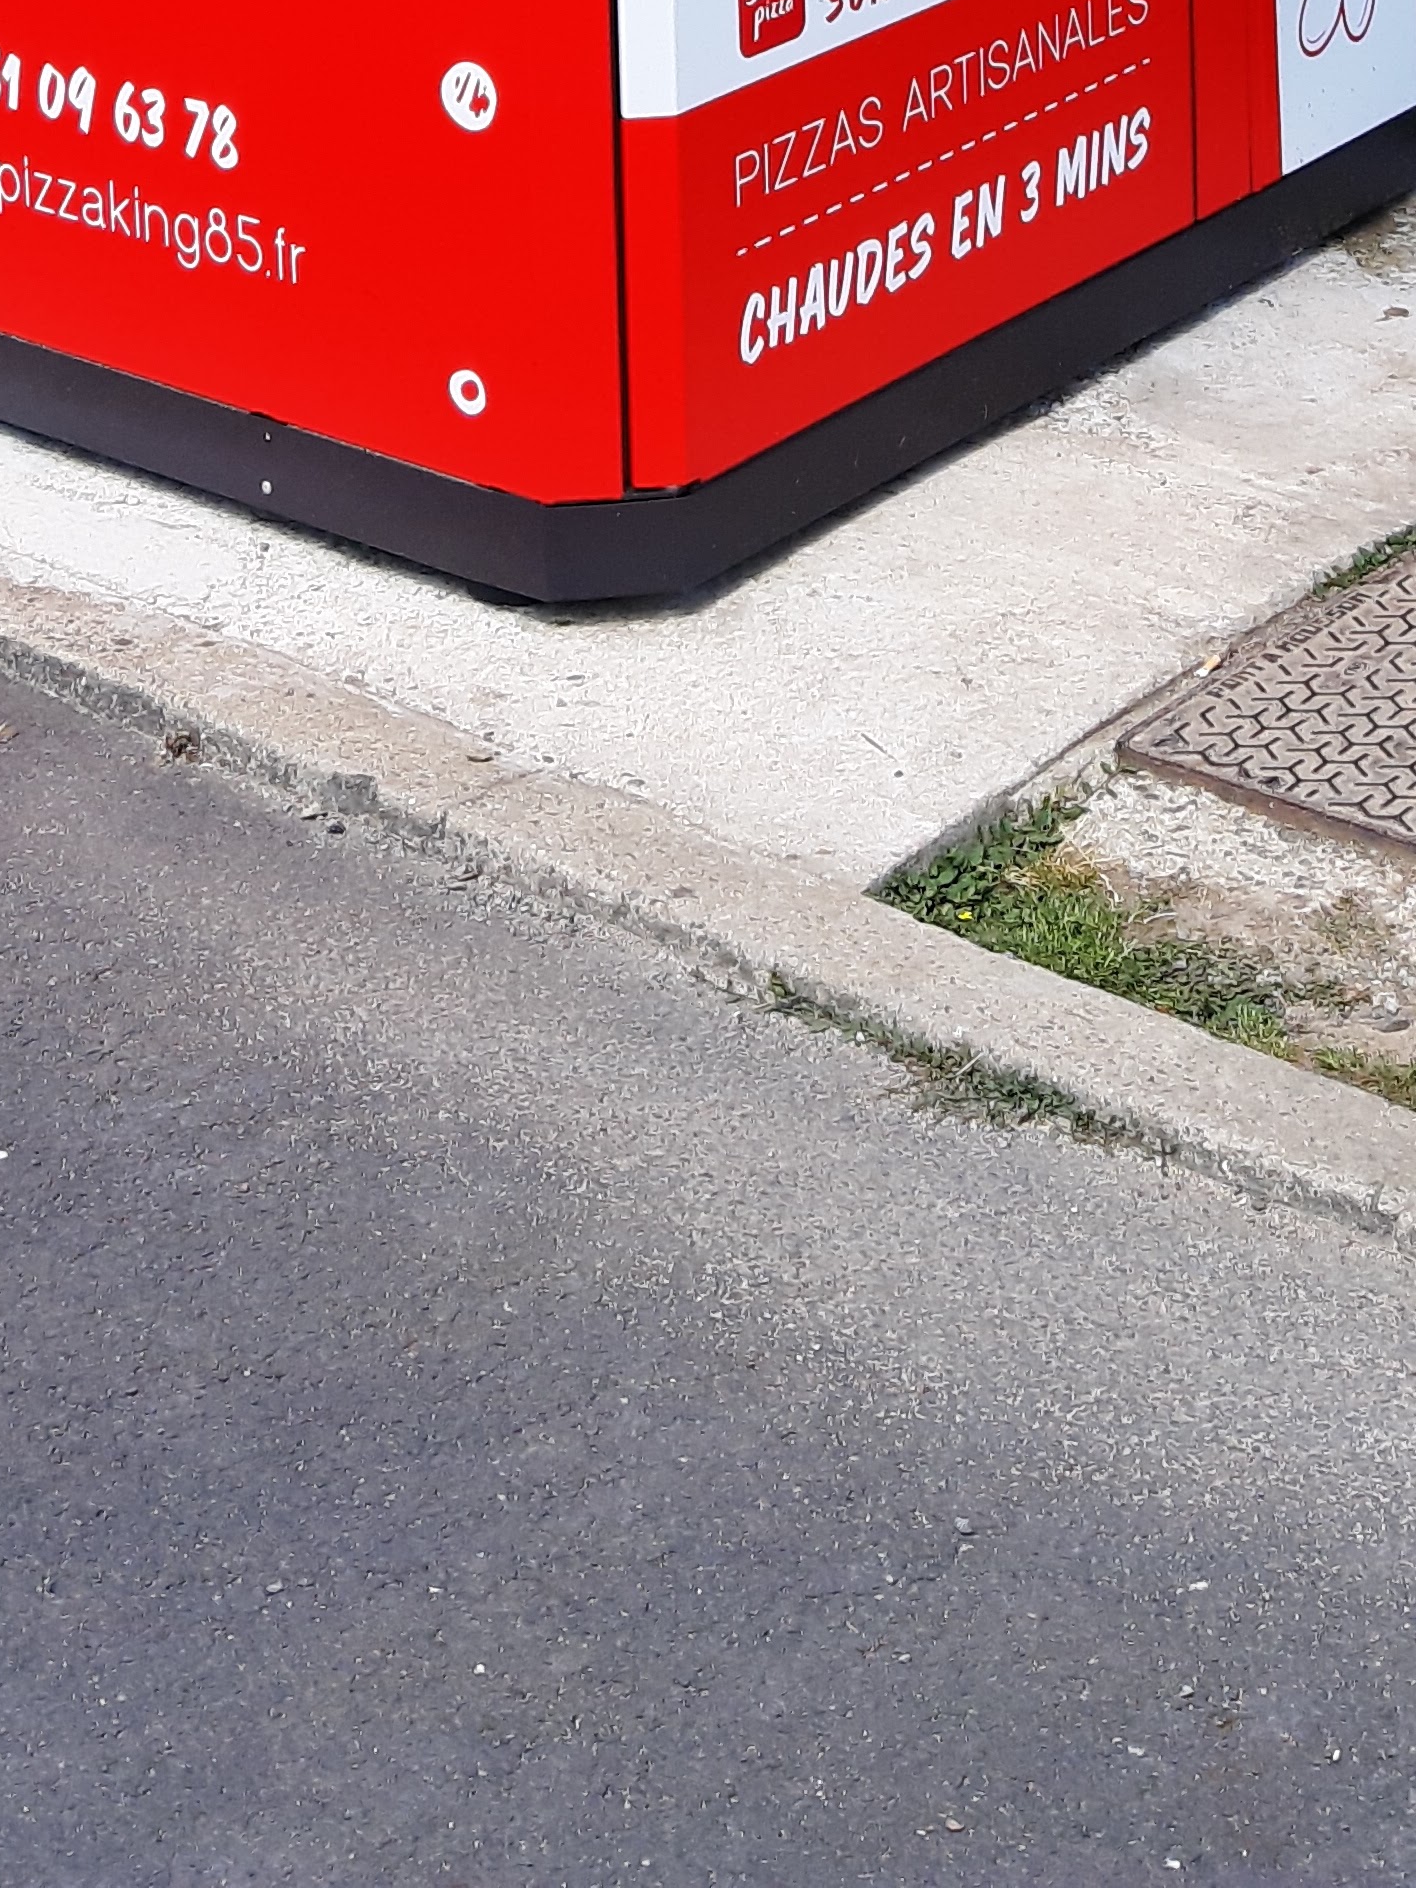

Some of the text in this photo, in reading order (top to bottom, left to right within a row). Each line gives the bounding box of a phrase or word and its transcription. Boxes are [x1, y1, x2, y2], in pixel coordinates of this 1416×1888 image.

[38, 62, 97, 135] 09
[114, 81, 166, 148] 63
[184, 97, 239, 170] 78
[735, 96, 883, 208] PIZZAS
[740, 106, 1151, 365] CHAUDES EN 3 MINS
